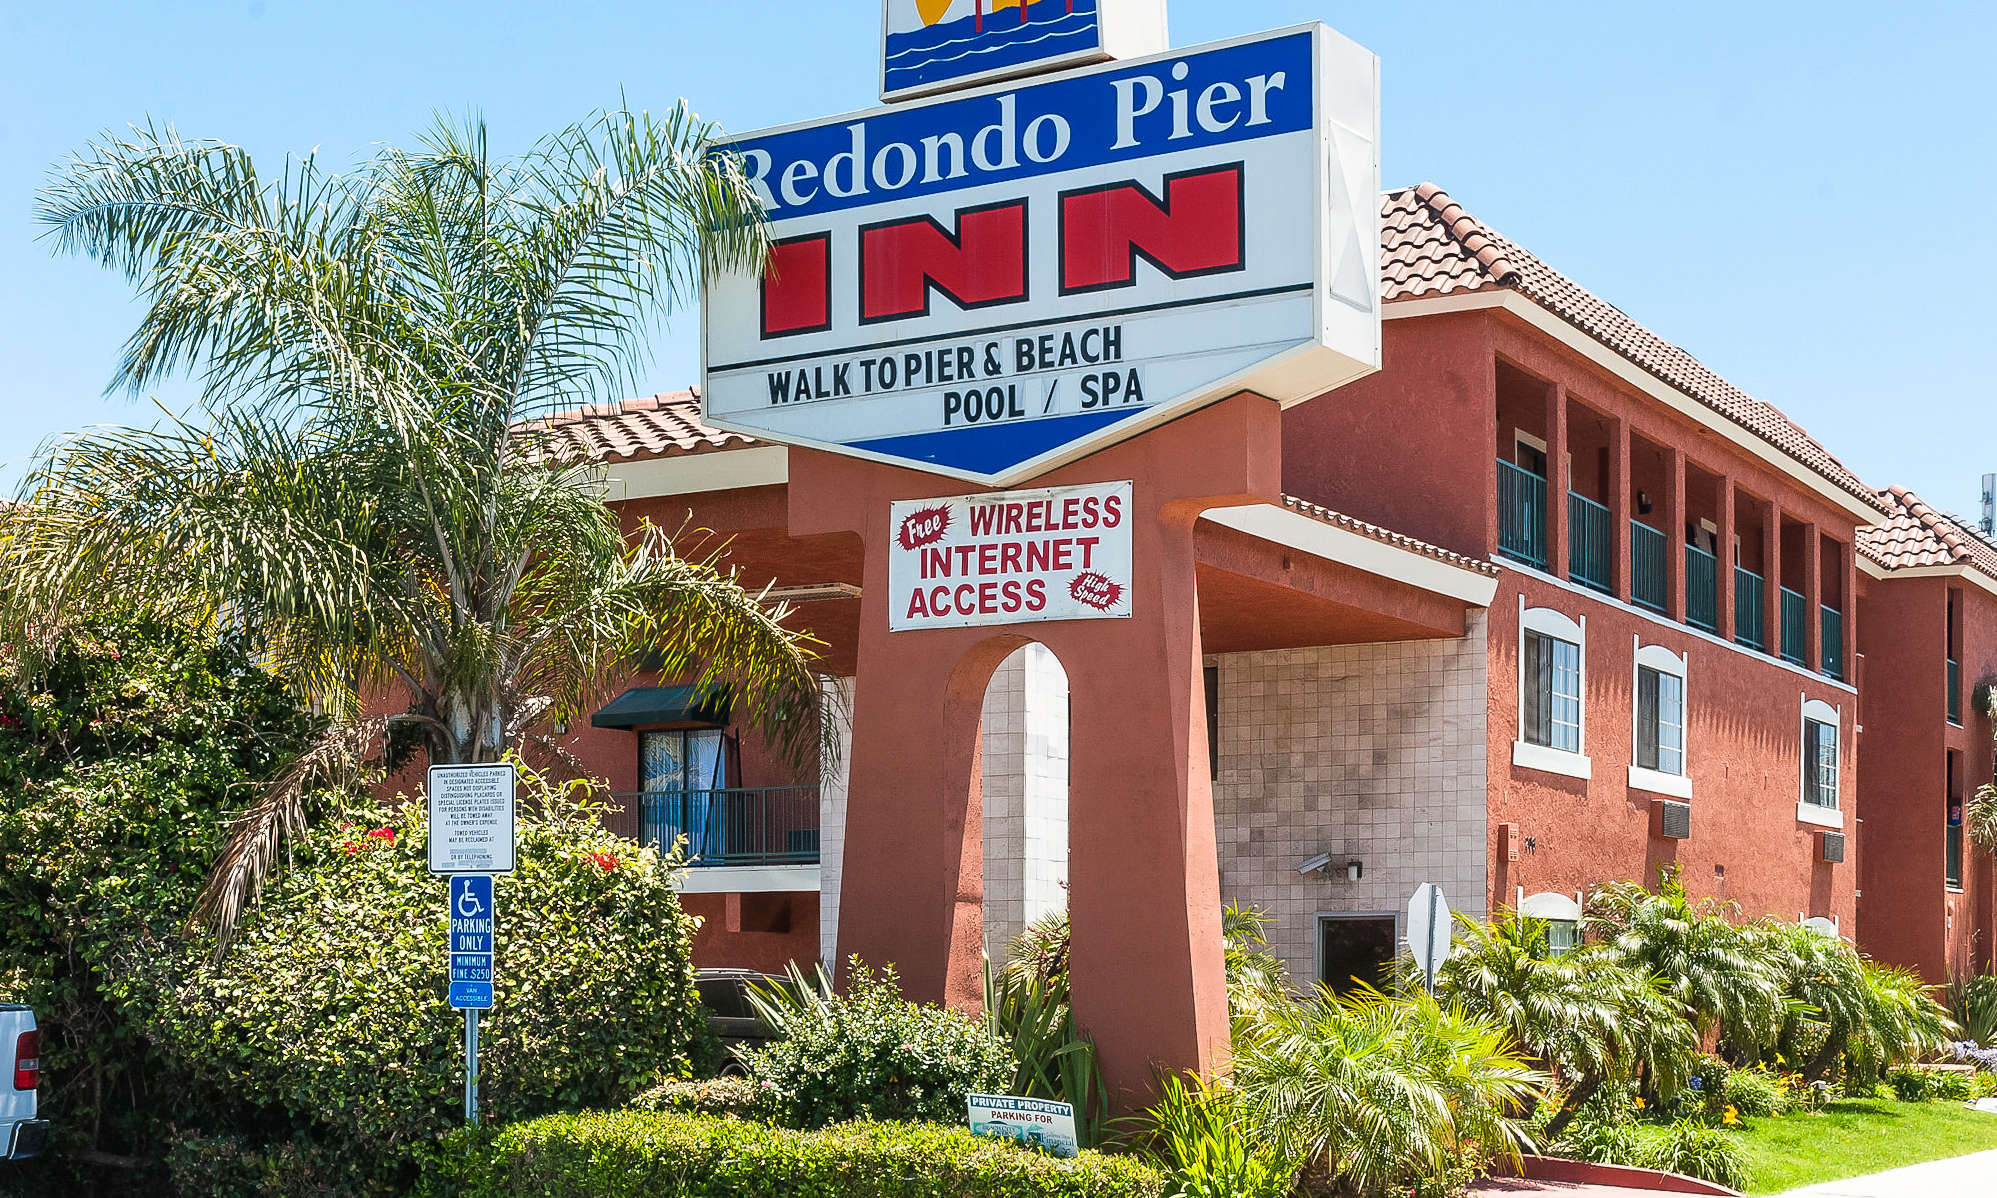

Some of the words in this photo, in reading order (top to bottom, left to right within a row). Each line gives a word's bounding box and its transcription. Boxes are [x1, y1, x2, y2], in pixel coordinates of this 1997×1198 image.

[733, 94, 1070, 213] Redondo
[1110, 62, 1285, 150] Pier
[760, 160, 1245, 340] INN
[768, 362, 850, 405] WALK
[859, 355, 897, 392] TO
[904, 345, 975, 387] PIER
[983, 341, 1002, 376] &
[1016, 325, 1122, 372] BEACH
[943, 385, 1025, 426] POOL
[1081, 367, 1144, 409] SPA
[969, 495, 1122, 536] WIRELESS
[907, 513, 942, 544] Free
[920, 537, 1100, 579] INTERNET
[1073, 586, 1111, 606] Speed
[1083, 575, 1110, 593] High
[906, 579, 1047, 619] ACCESS
[452, 918, 491, 934] PARKING
[459, 935, 484, 951] ONLY
[456, 956, 486, 966] MINIMUM
[452, 968, 468, 979] FINE
[471, 968, 490, 980] $250
[972, 1097, 1015, 1109] PRIVATE
[1017, 1100, 1070, 1115] PROPERTY
[991, 1110, 1032, 1122] PARKING
[1034, 1114, 1053, 1124] FOR
